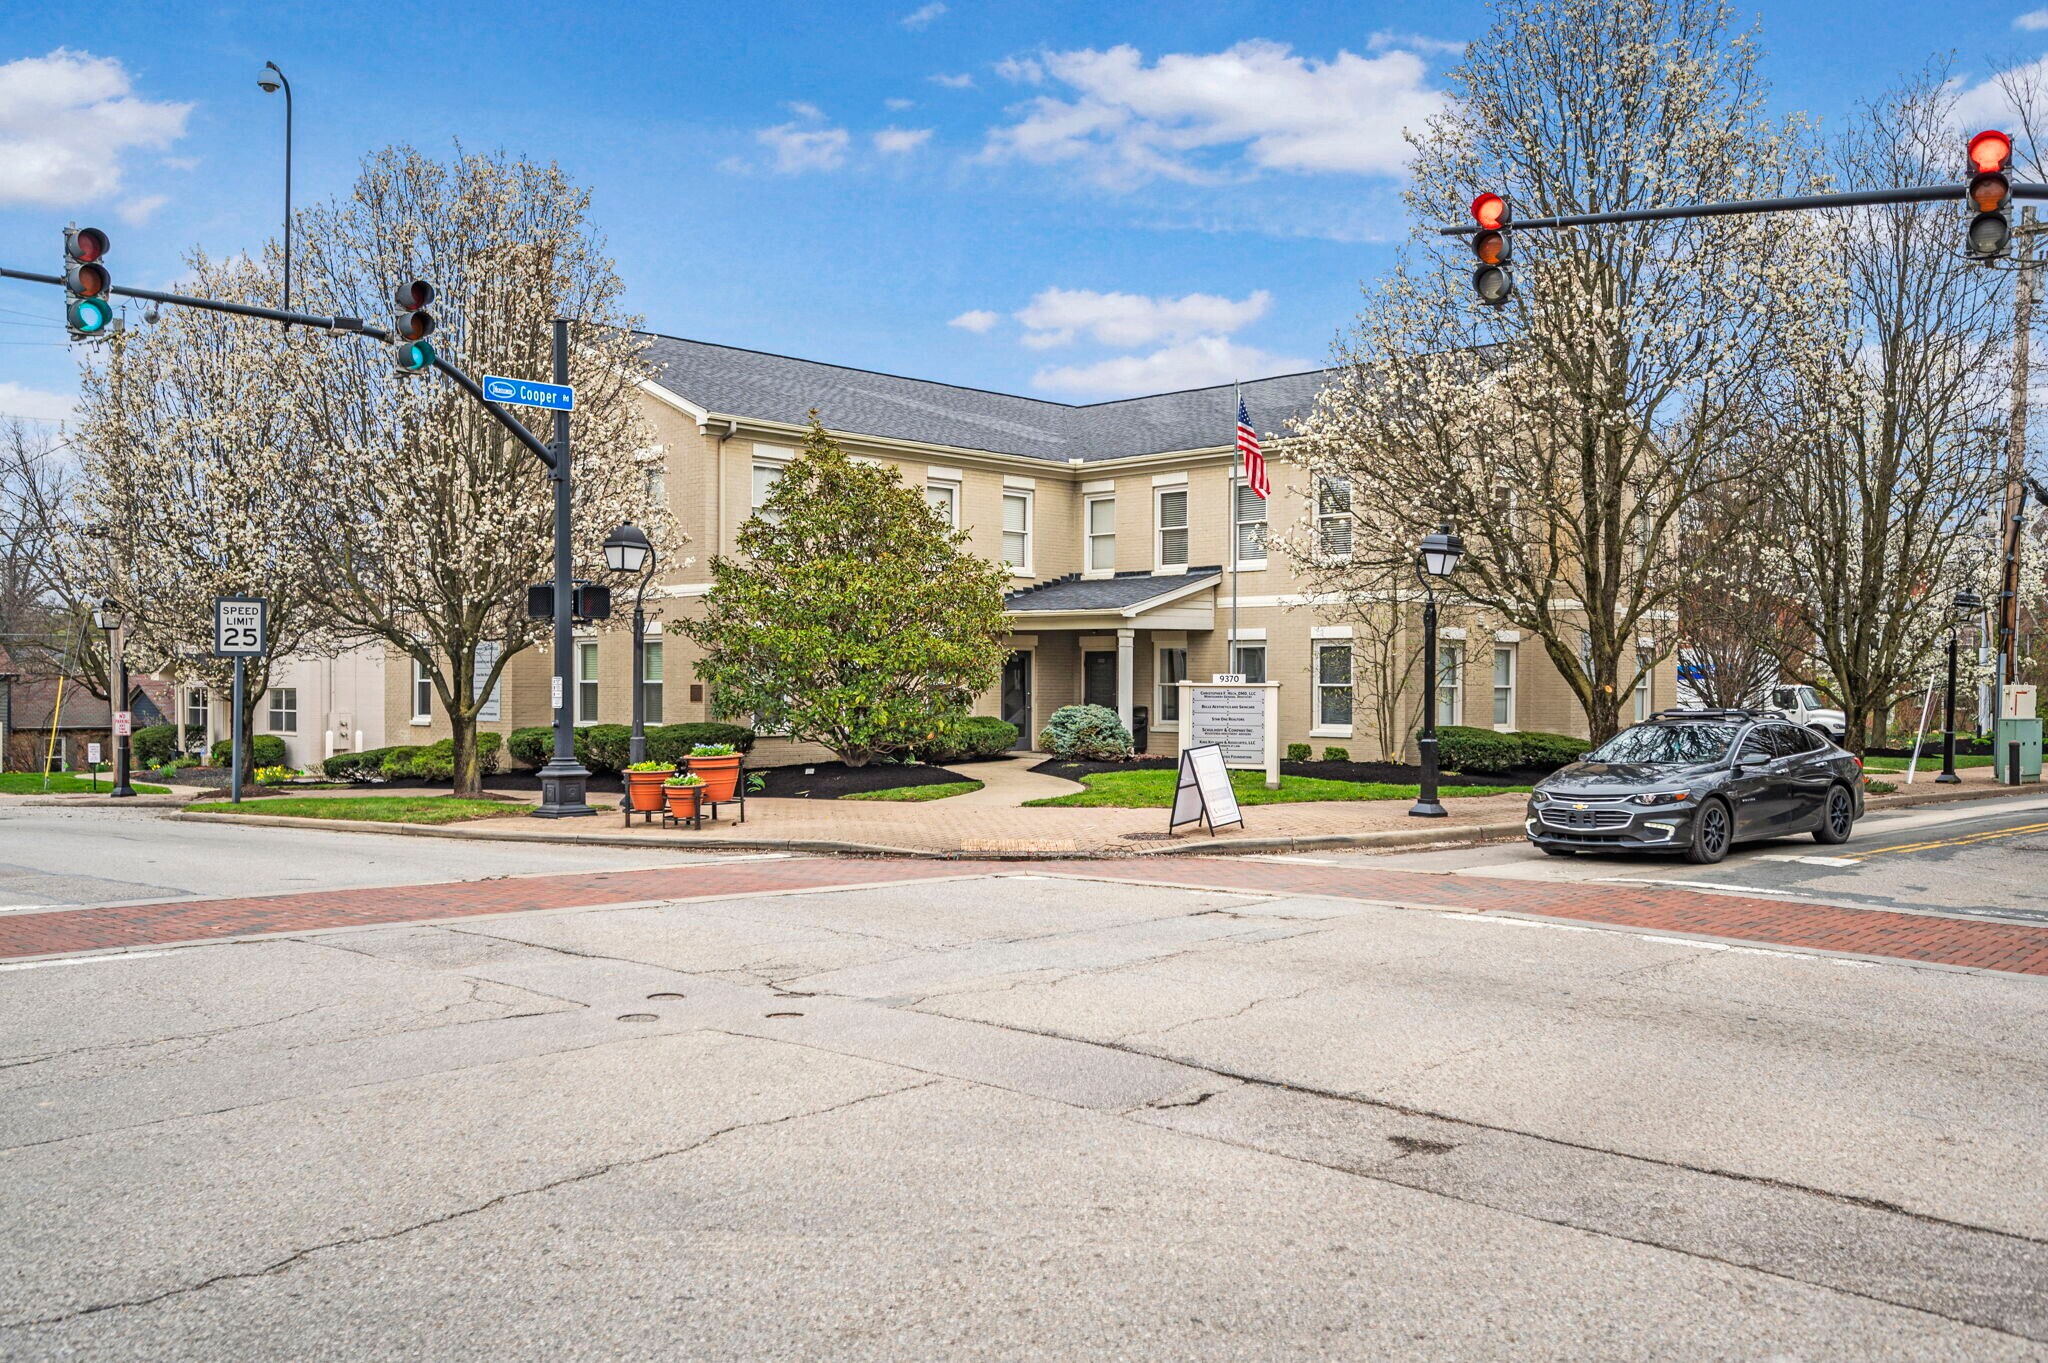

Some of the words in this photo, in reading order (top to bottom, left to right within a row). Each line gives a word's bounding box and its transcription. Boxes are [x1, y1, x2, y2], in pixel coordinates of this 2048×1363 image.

[520, 386, 557, 405] Cooper
[223, 607, 259, 615] SPEED
[226, 617, 254, 626] LIMIT
[224, 628, 258, 646] 25
